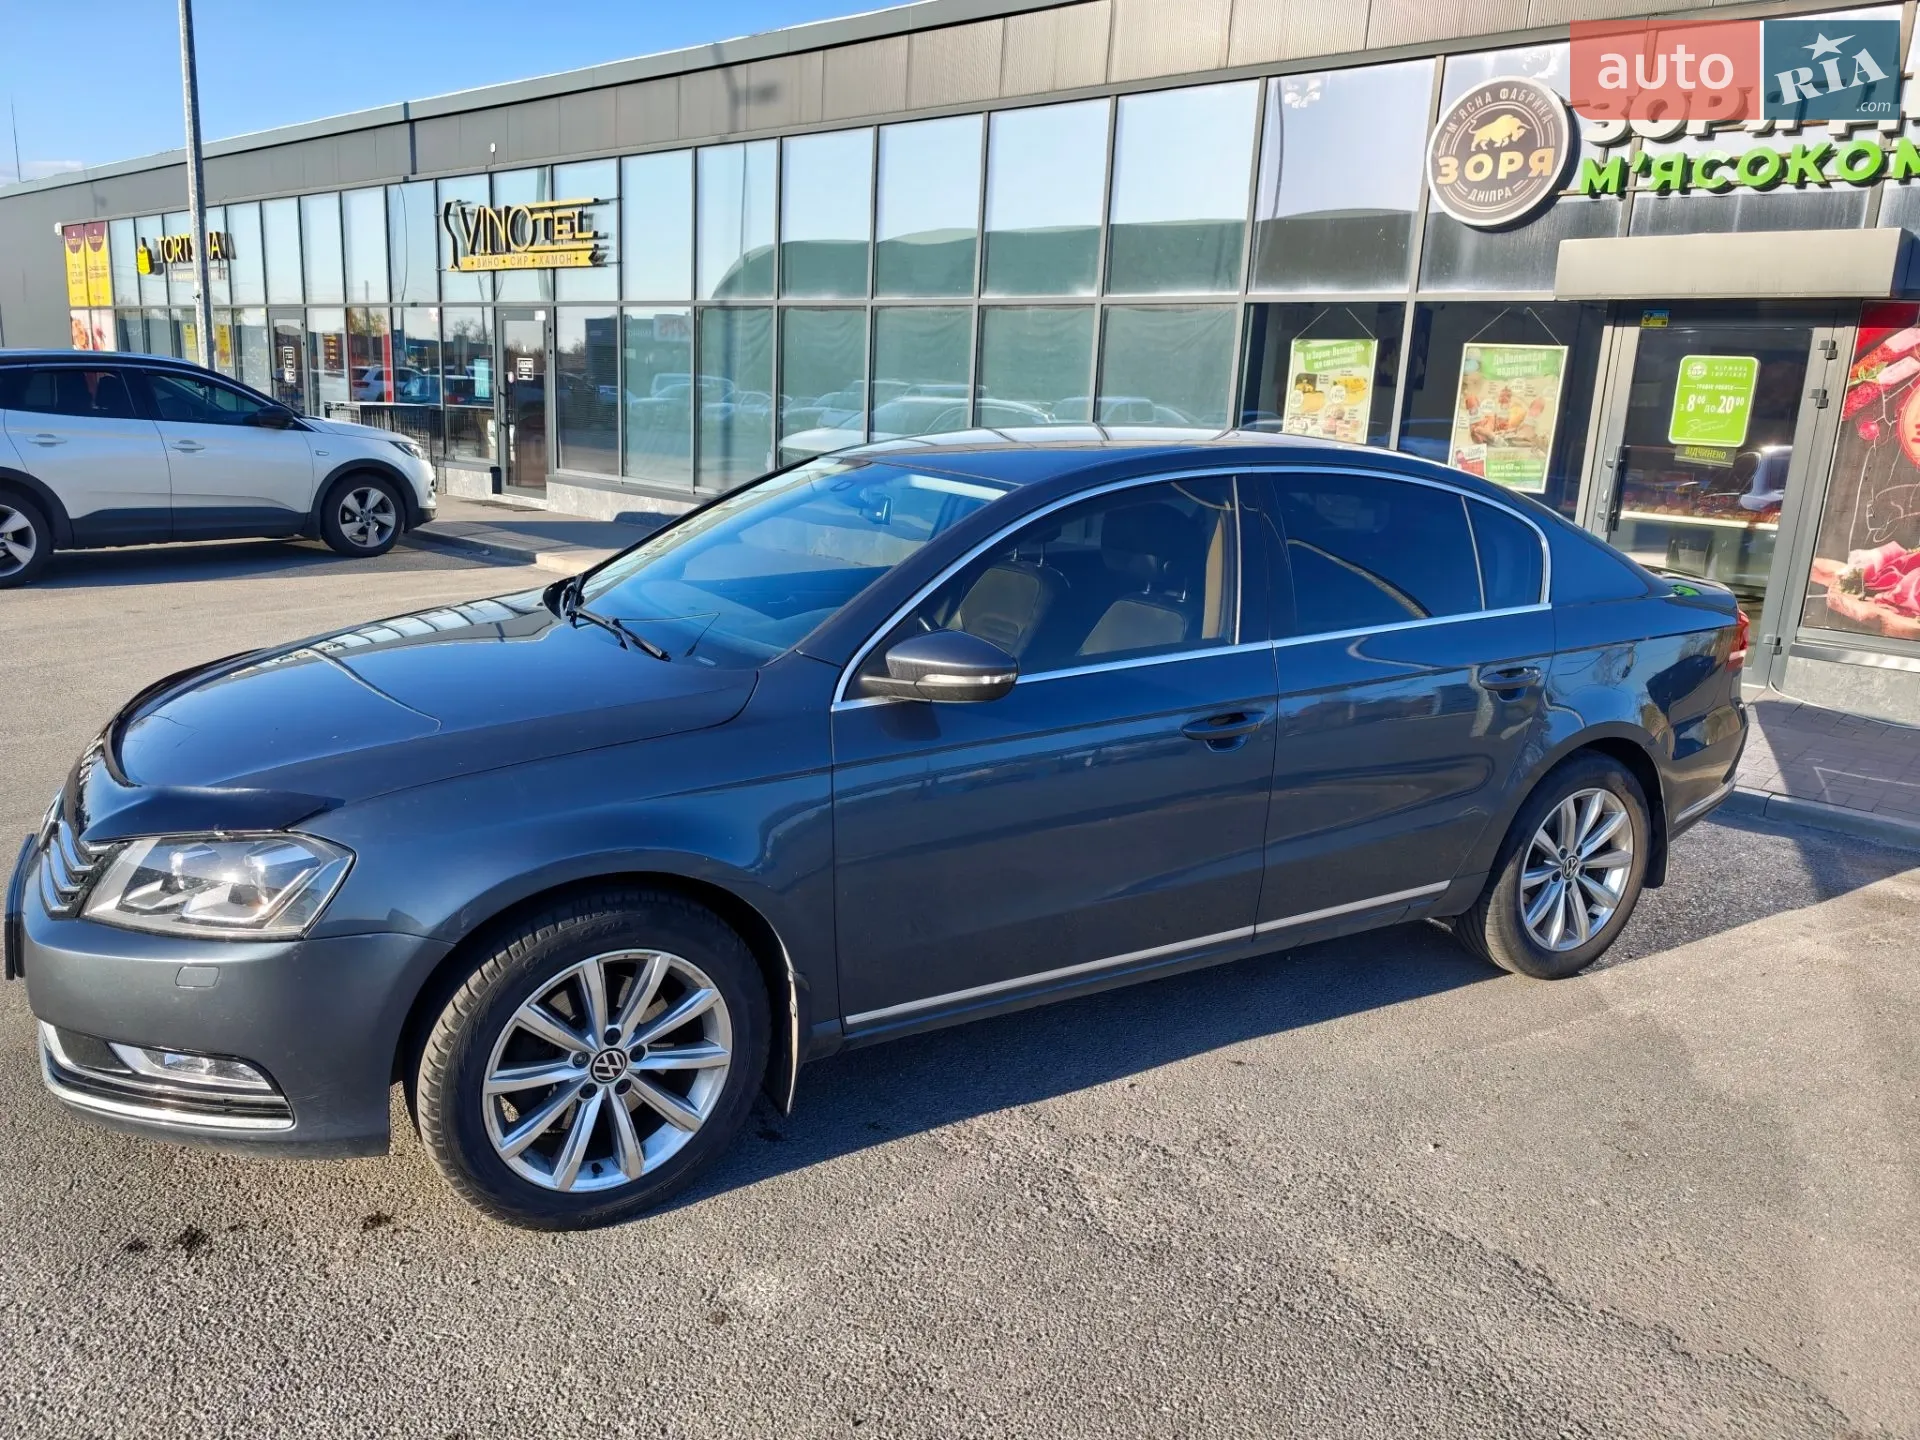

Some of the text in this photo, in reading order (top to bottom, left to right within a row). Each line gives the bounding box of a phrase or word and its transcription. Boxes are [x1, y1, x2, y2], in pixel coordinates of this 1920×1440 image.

[1500, 88, 1553, 124] ФАБРИКА
[1436, 148, 1555, 185] ЗОРЯ
[1468, 186, 1513, 203] ДНІПРА
[477, 253, 573, 269] ВИНО СИР ХАМОН
